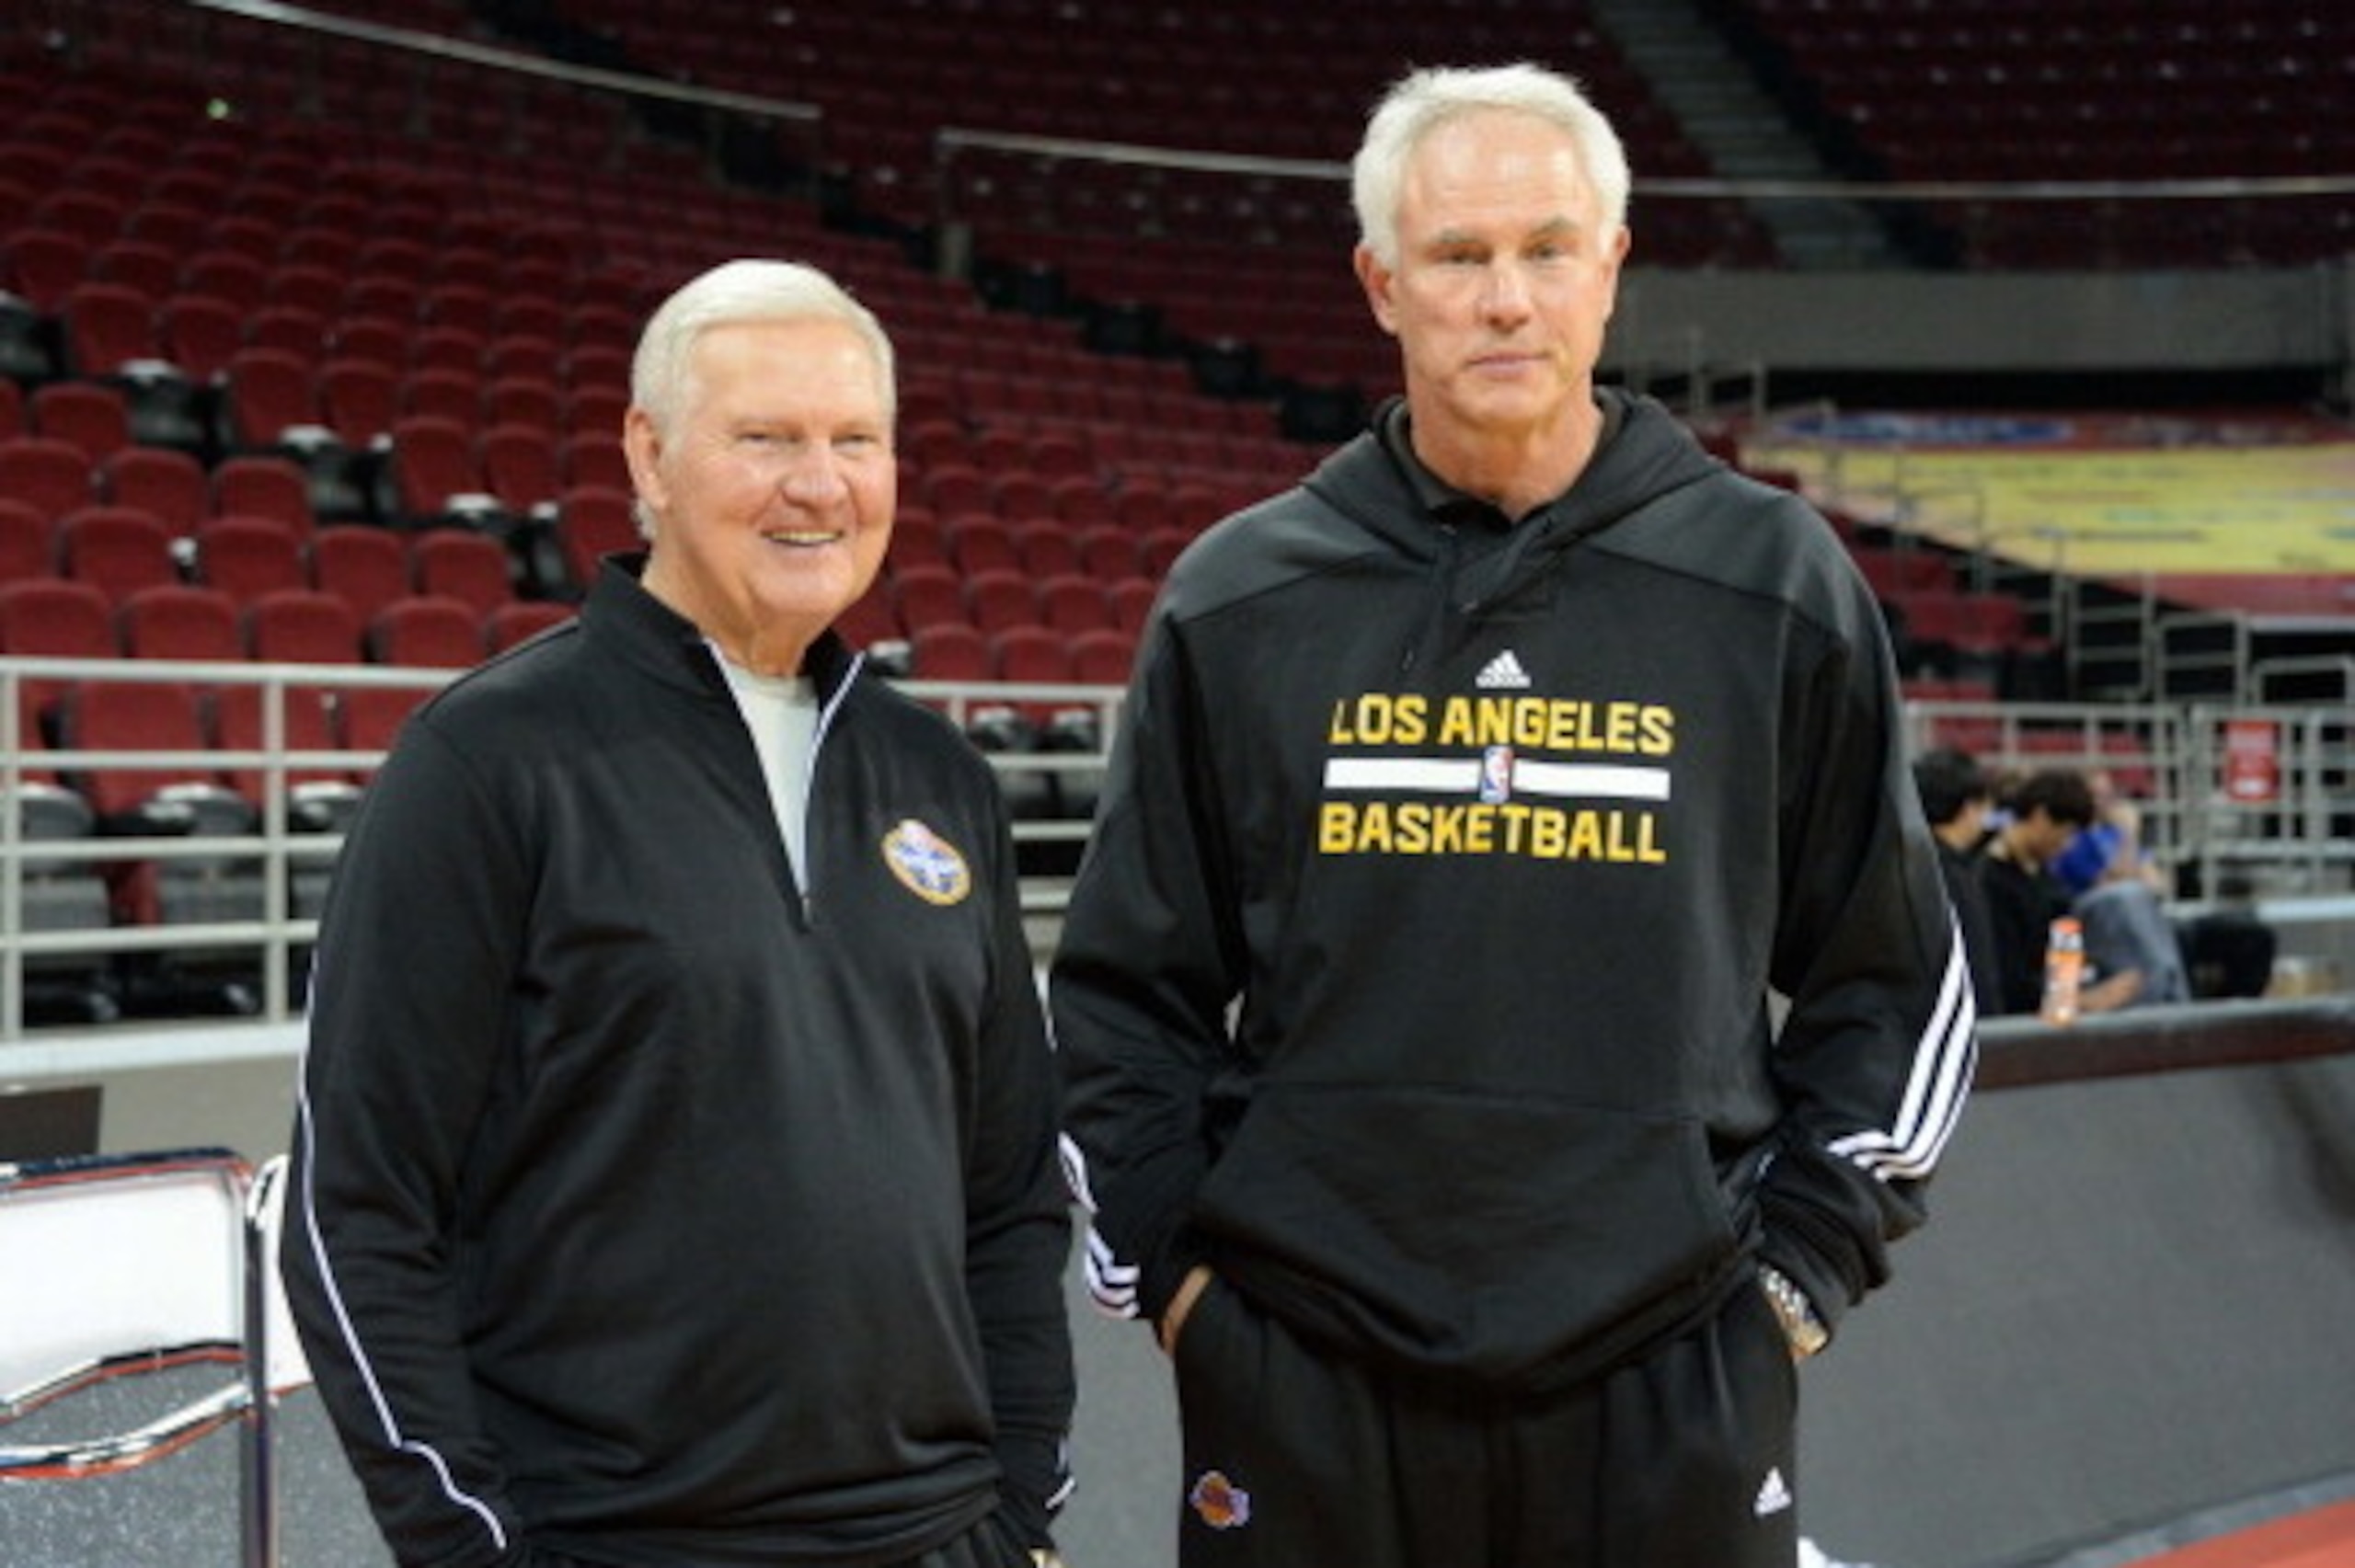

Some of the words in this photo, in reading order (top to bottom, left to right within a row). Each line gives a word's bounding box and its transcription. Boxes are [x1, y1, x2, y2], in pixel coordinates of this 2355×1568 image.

[1329, 693, 1428, 746] LOS
[1437, 696, 1675, 755] ANGELES
[1318, 802, 1667, 864] BASKETBALL
